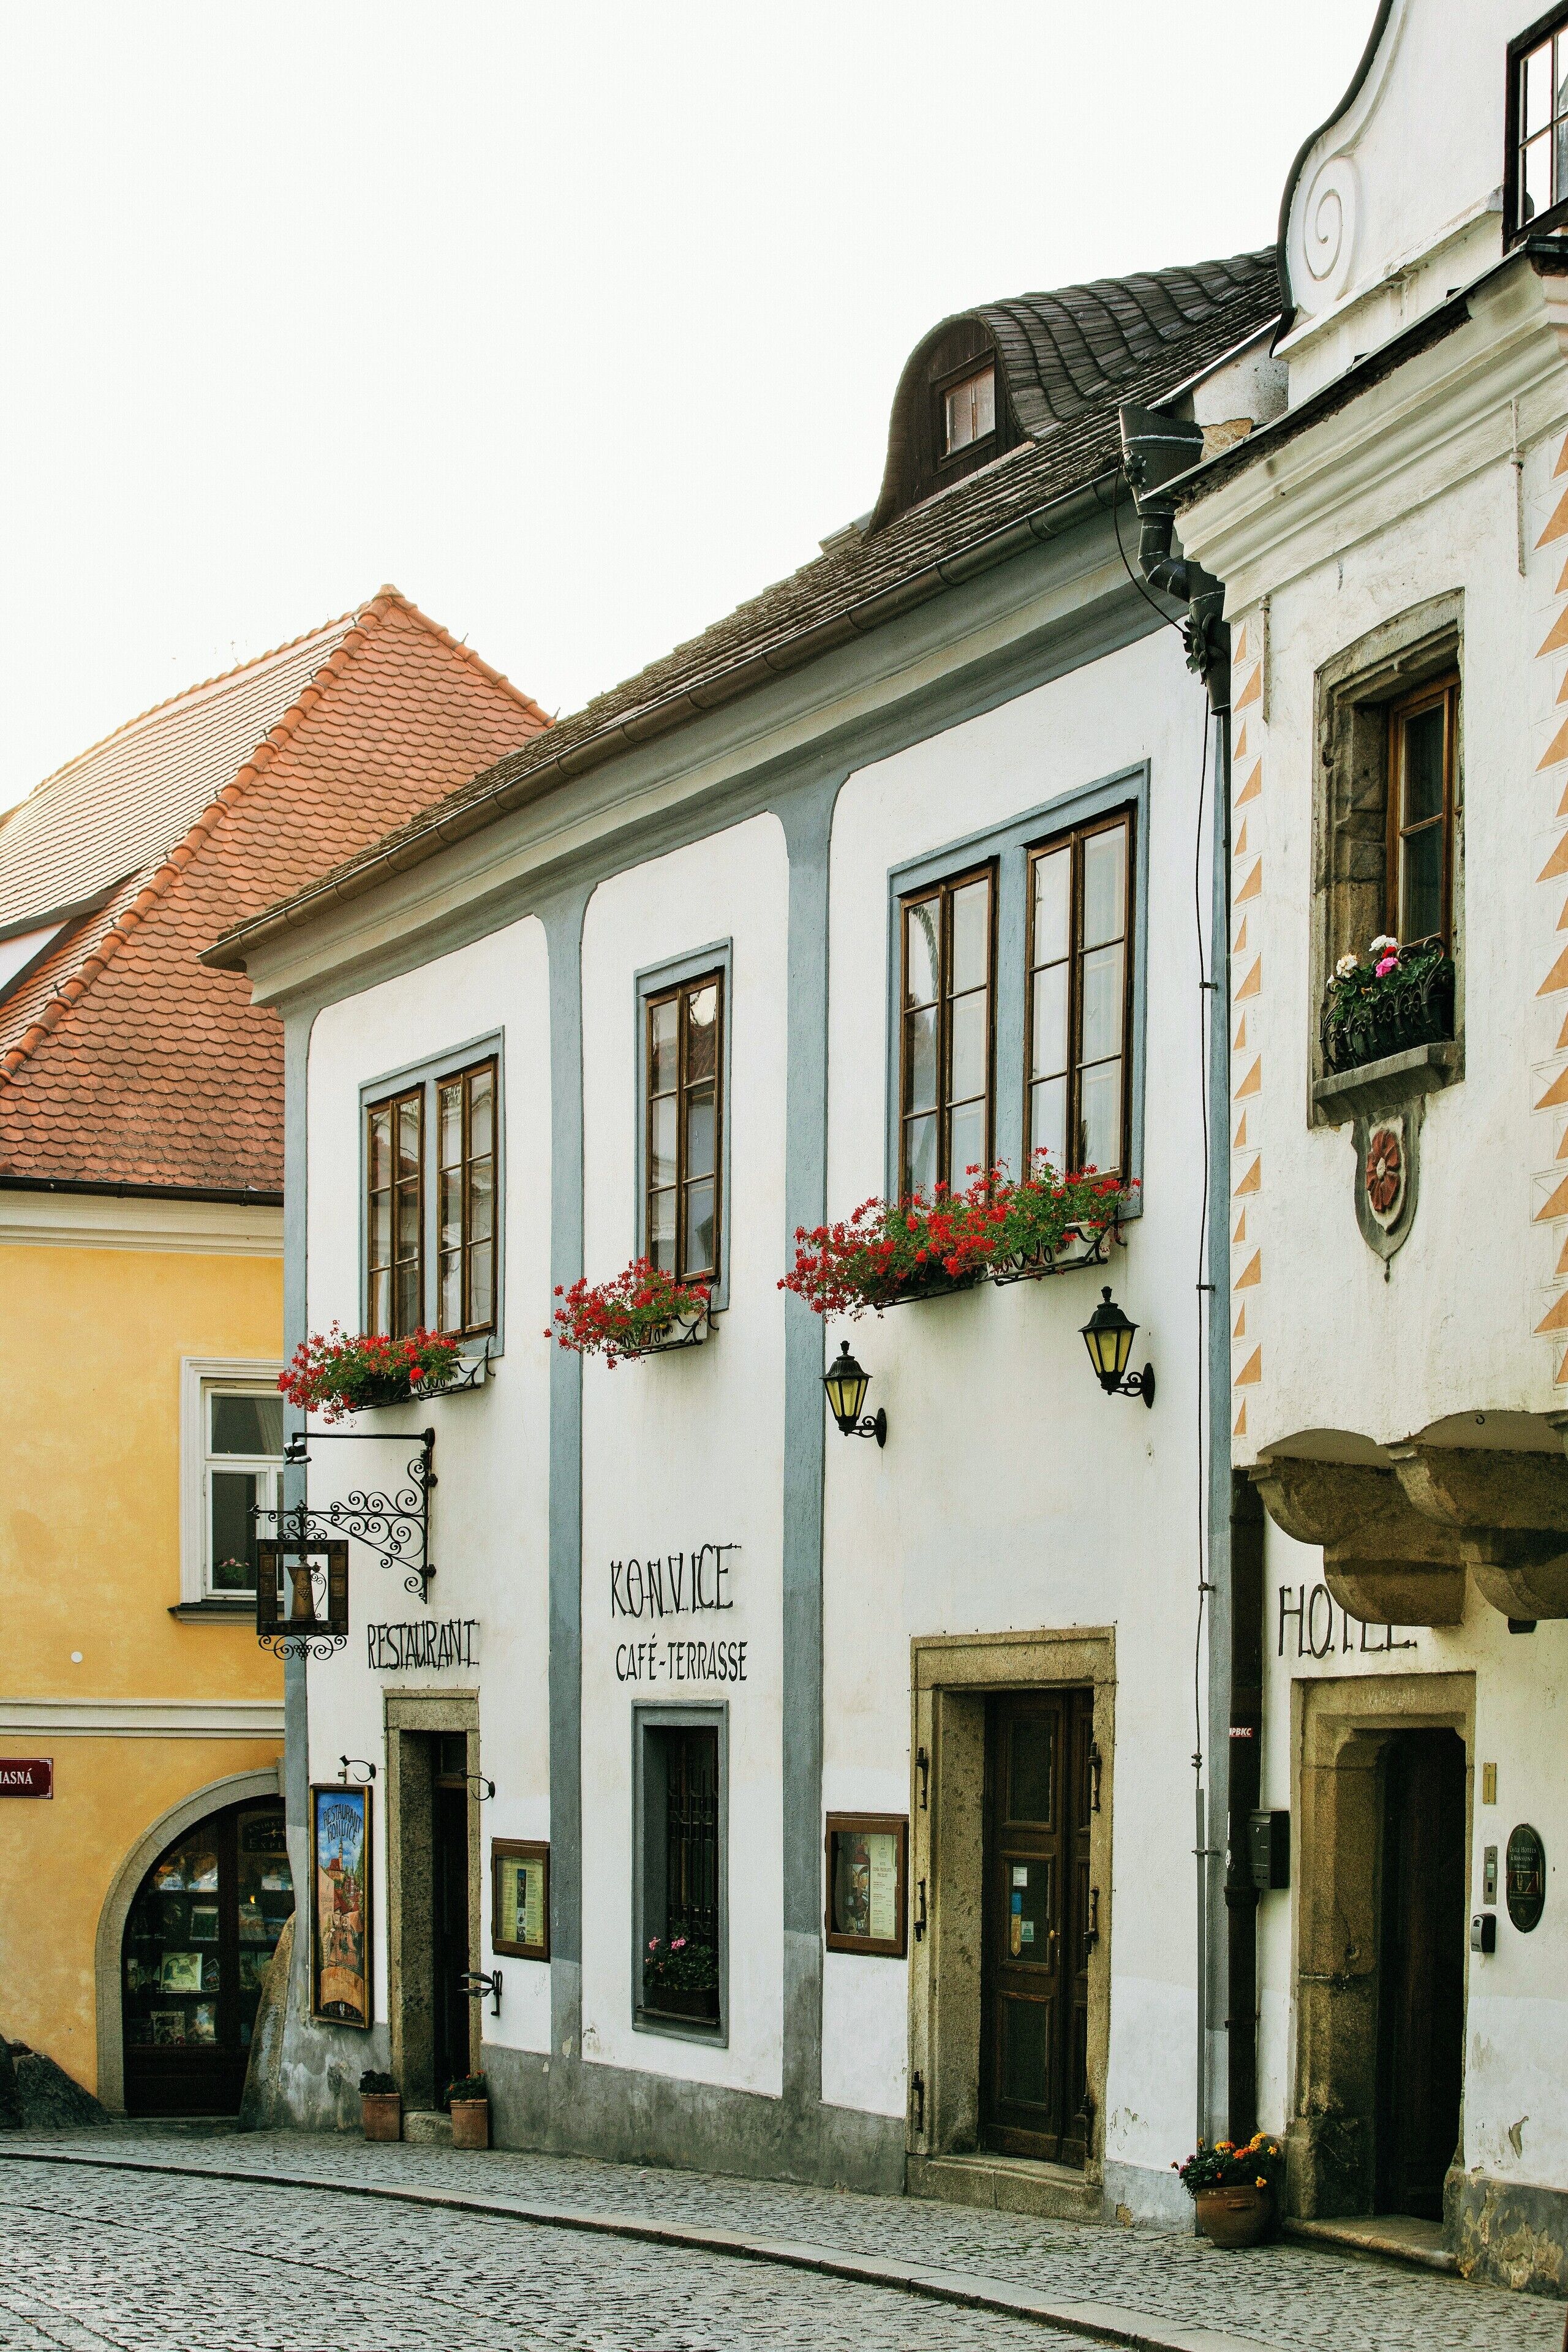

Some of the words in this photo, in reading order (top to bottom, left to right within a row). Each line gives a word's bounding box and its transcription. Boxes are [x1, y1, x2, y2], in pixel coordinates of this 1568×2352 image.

[611, 1543, 734, 1619] KONVICE
[367, 1618, 477, 1671] RESTAURANT
[616, 1632, 748, 1682] CAFÉ-TERRASSE
[323, 1804, 362, 1833] RESTAURANT
